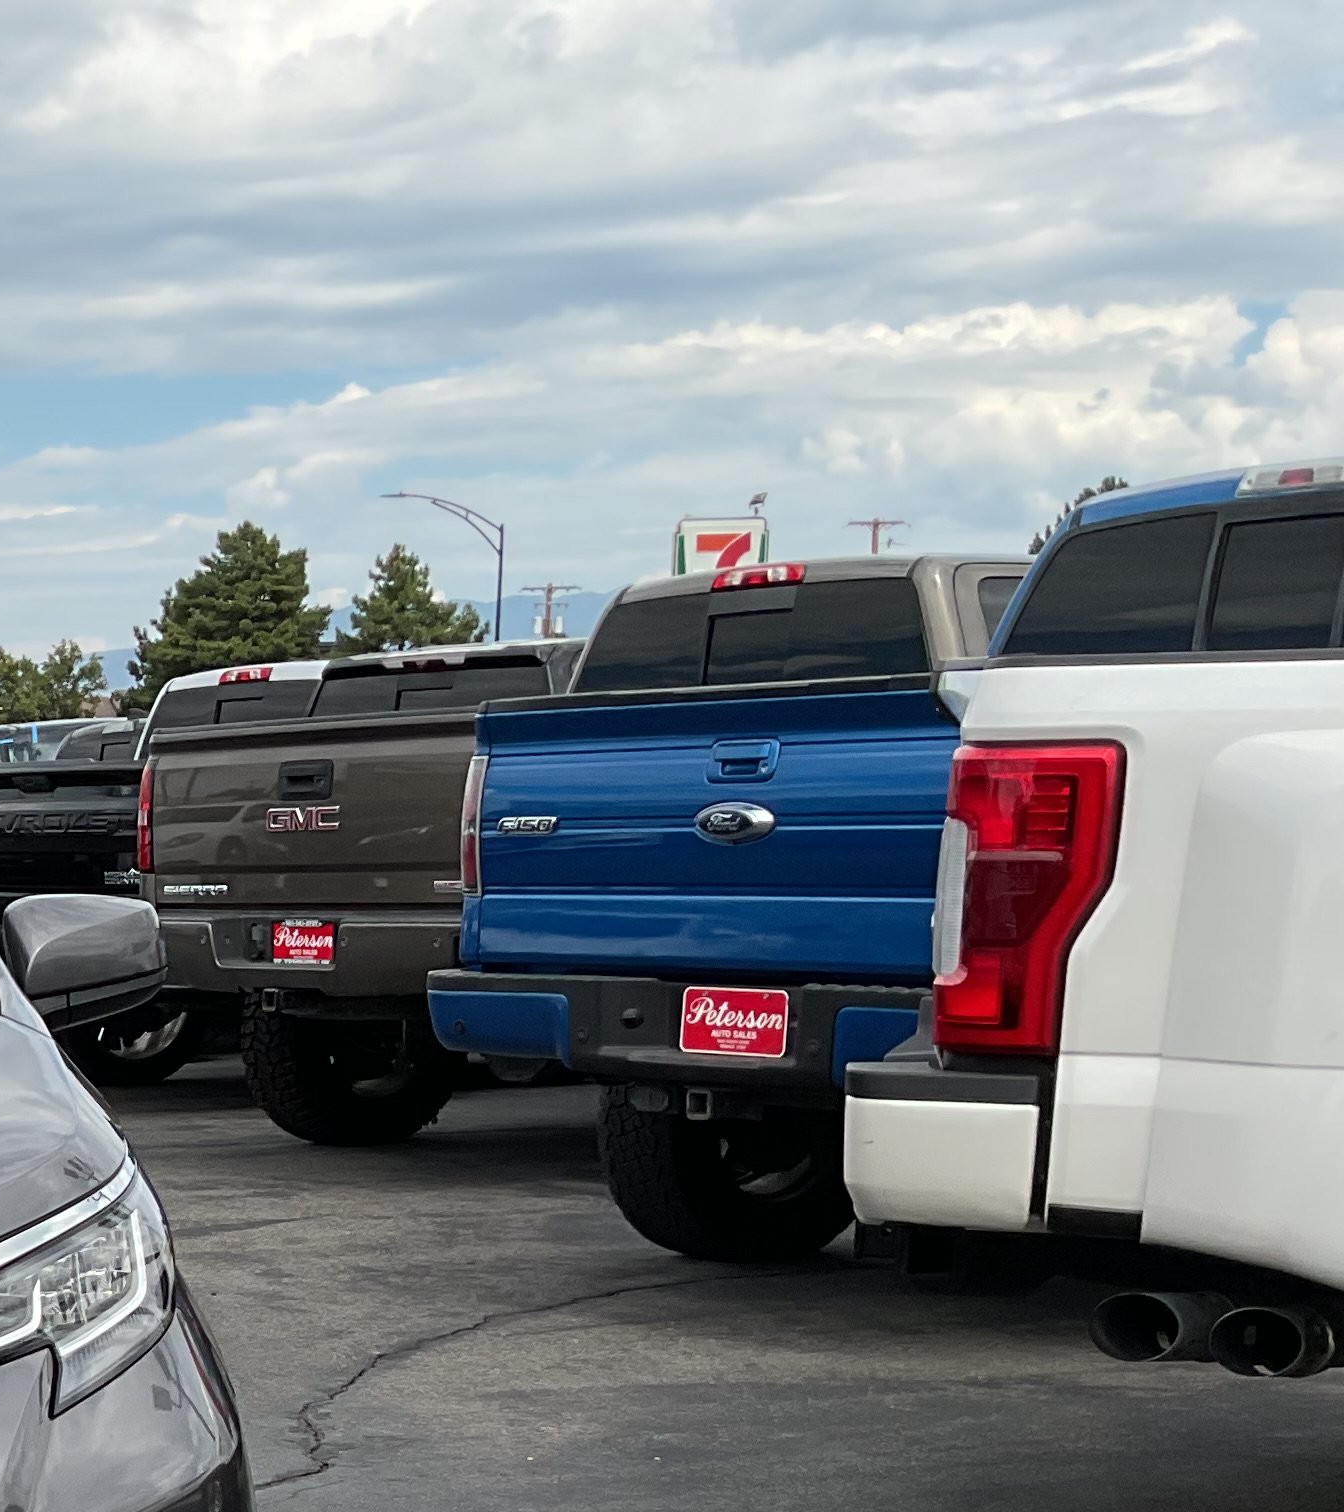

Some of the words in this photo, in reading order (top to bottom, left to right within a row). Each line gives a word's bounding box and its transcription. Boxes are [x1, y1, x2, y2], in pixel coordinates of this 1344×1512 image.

[265, 805, 340, 832] GMC
[273, 926, 334, 948] Peterson
[685, 996, 783, 1030] Peterson
